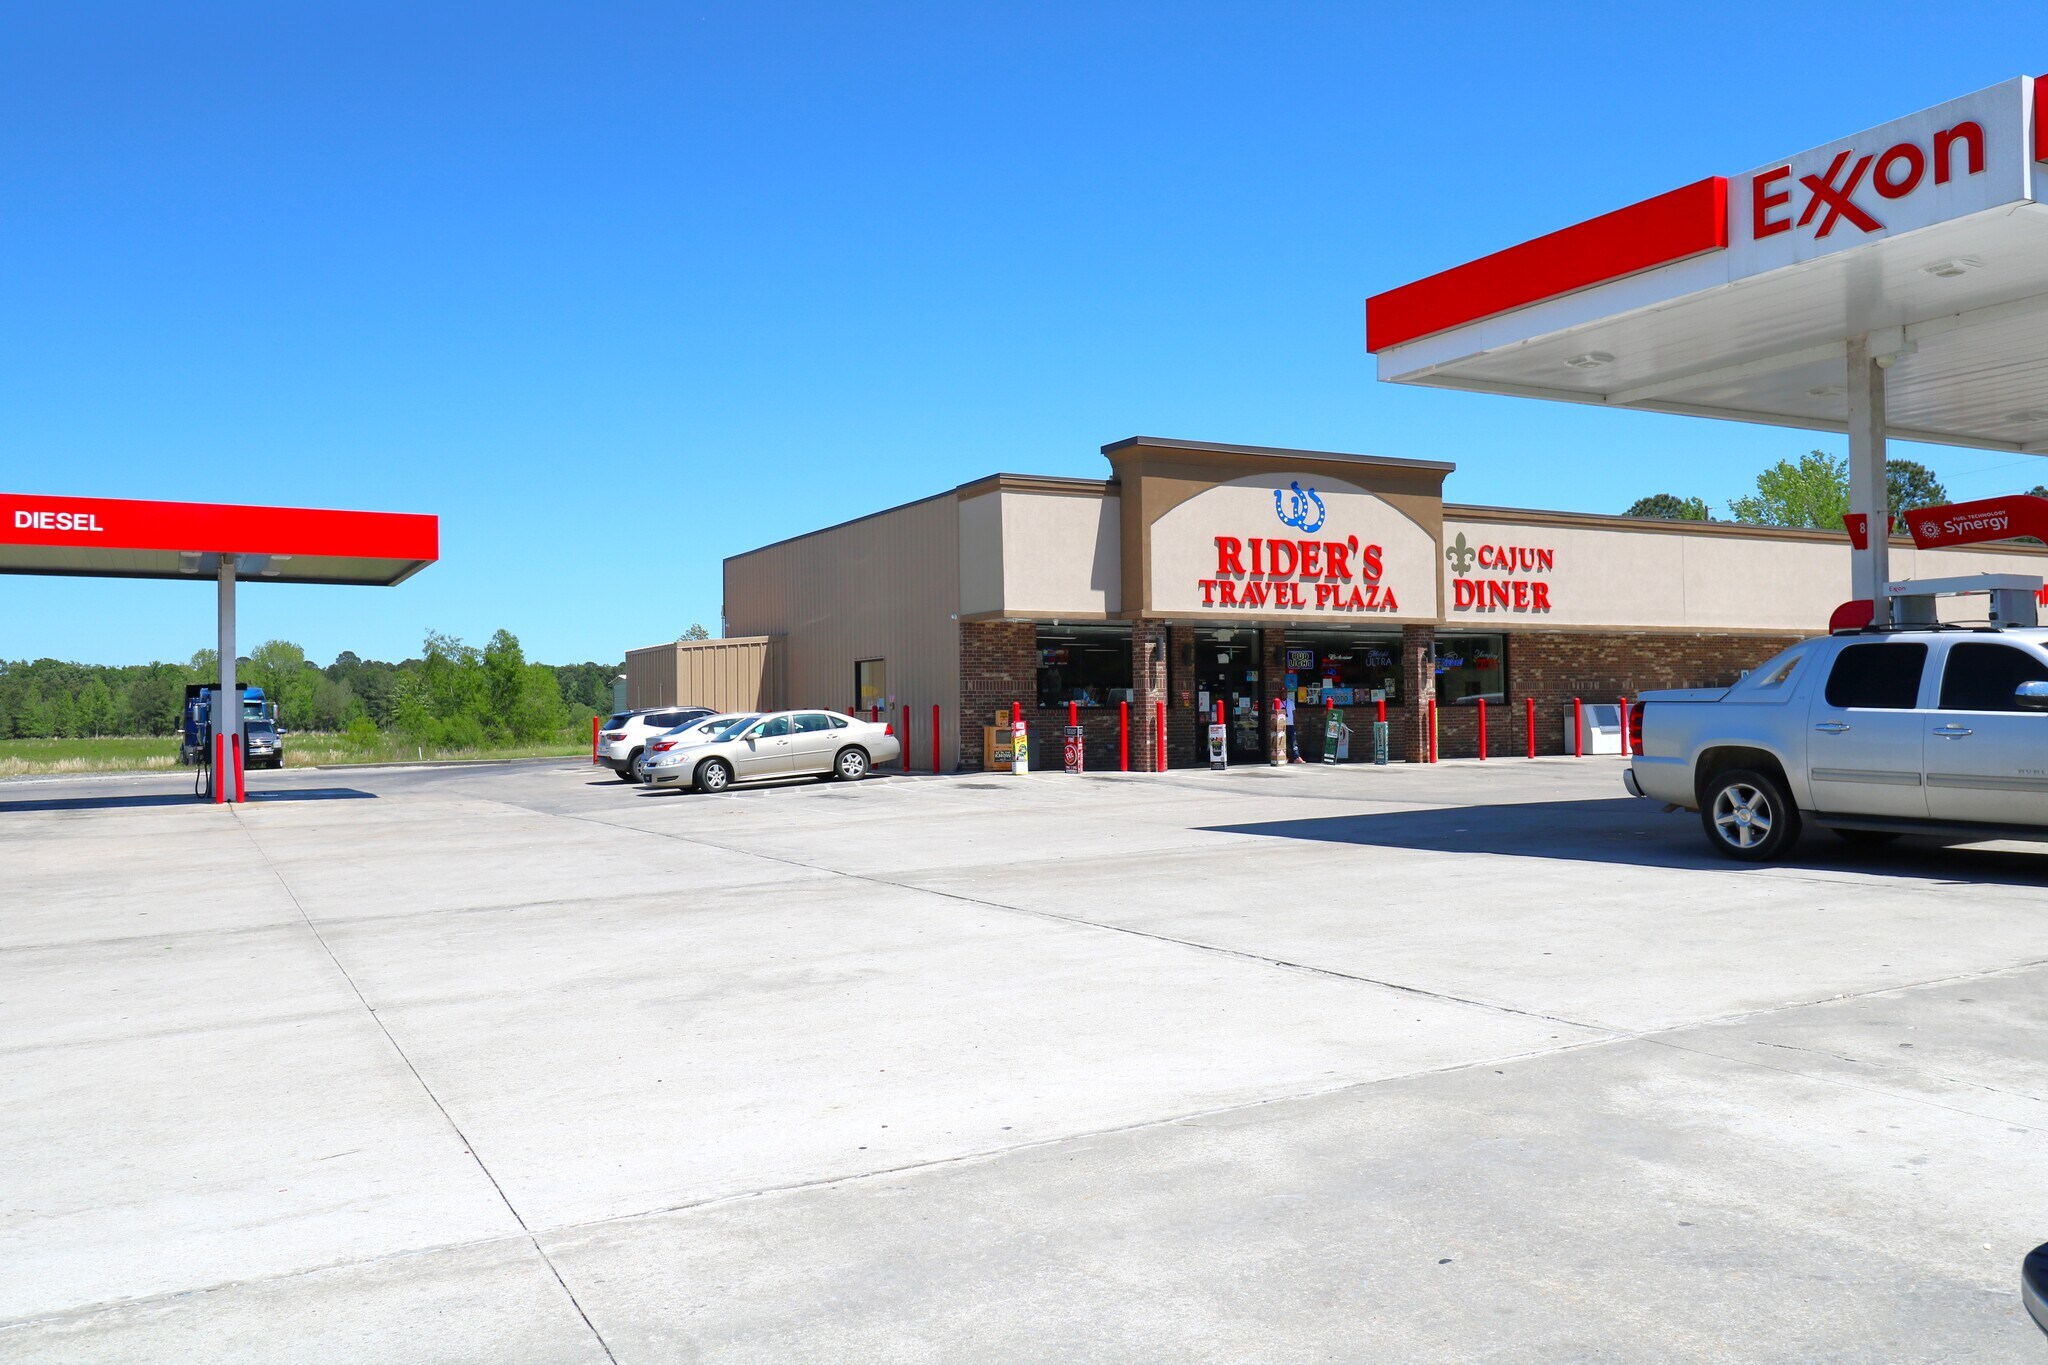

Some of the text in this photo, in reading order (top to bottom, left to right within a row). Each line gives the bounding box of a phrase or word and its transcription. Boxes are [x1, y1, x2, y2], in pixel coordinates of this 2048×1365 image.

[1752, 121, 1987, 240] Exxon
[14, 511, 104, 532] DIESEL
[1968, 510, 2007, 519] TECHNOLOGY
[1859, 522, 1866, 534] 8
[1944, 516, 2009, 535] Synergy
[1213, 534, 1384, 584] RIDER'S
[1478, 544, 1555, 573] CAJUN
[1198, 578, 1399, 610] TRAVEL PLAZA
[1453, 578, 1552, 610] DINER
[1888, 585, 1907, 593] Exxon
[1289, 660, 1312, 668] LIGHT
[1291, 652, 1310, 660] BUD
[1365, 657, 1393, 667] ULTRA
